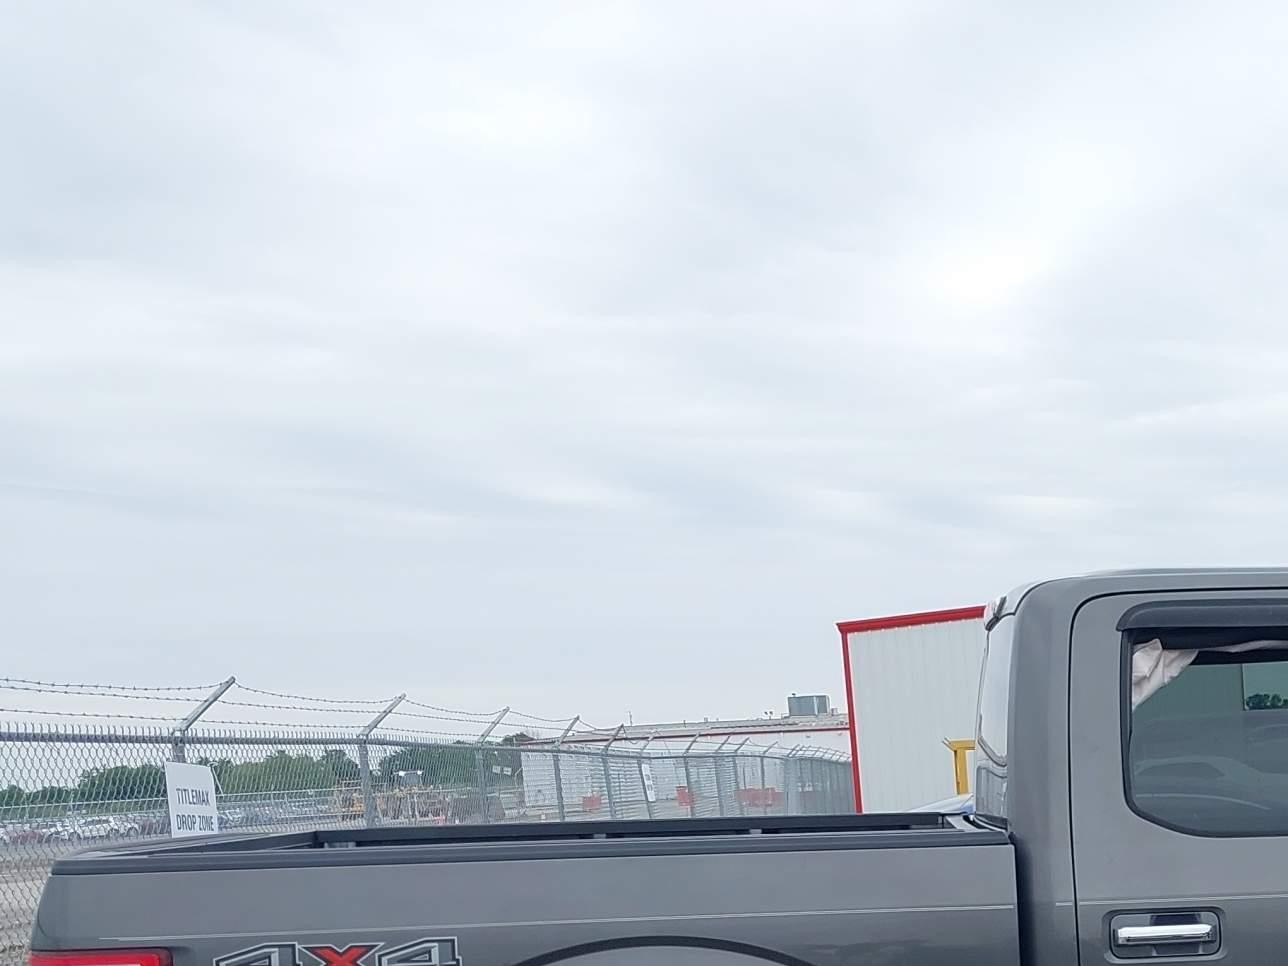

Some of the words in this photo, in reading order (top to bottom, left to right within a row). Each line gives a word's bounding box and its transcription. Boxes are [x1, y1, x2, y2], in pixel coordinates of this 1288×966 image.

[176, 788, 211, 806] TITLEMAX
[176, 814, 196, 831] DROP
[198, 815, 215, 831] ZONE
